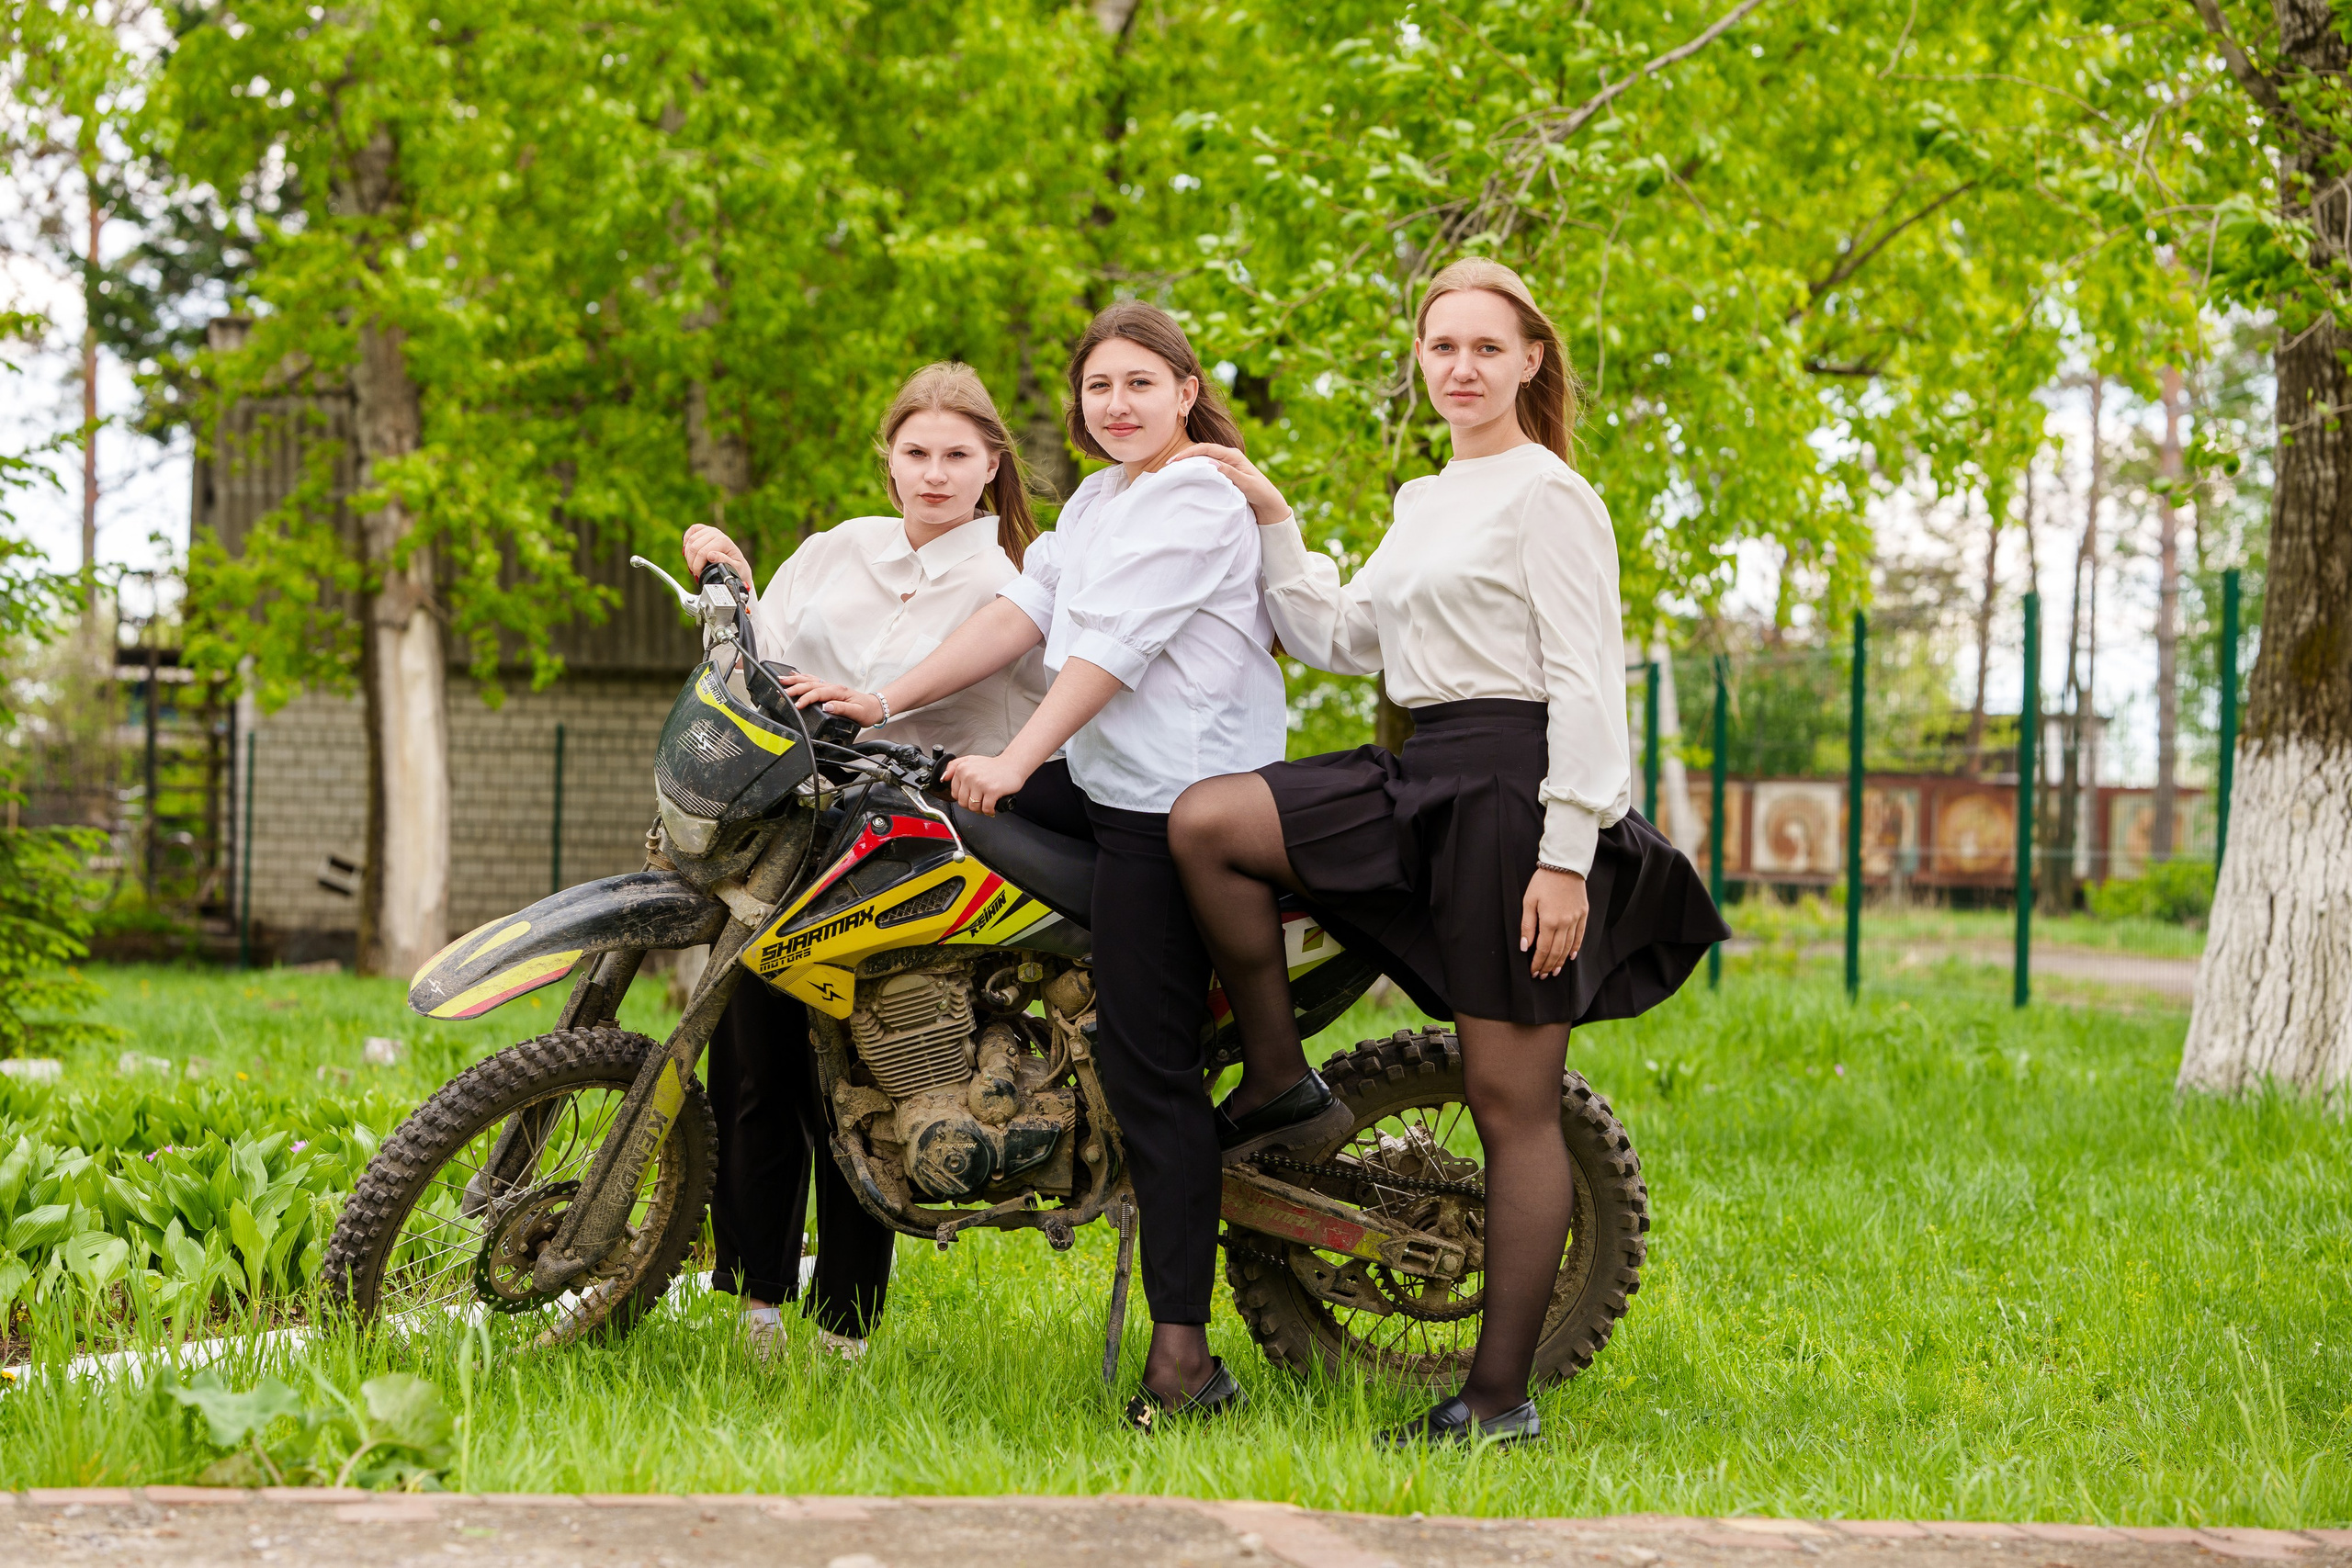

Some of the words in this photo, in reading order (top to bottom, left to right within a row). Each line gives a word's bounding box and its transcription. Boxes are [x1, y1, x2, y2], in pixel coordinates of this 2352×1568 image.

[760, 905, 875, 963] SHARMAX
[968, 889, 1007, 938] KEIHIN
[760, 948, 811, 972] MOTORS
[608, 1108, 670, 1207] KENDA
